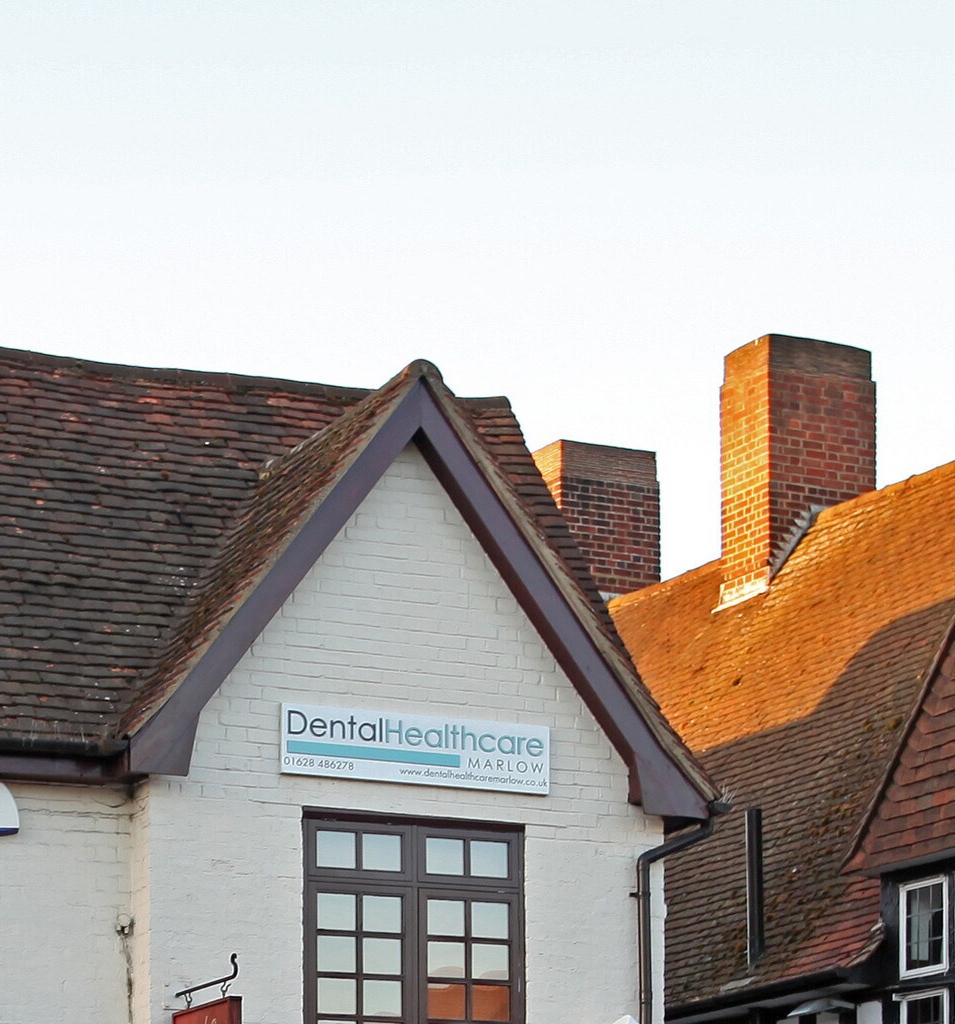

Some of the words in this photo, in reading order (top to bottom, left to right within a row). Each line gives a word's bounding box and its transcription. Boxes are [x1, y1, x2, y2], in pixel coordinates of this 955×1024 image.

[283, 756, 315, 768] 01628
[317, 759, 355, 771] 486278
[467, 757, 544, 774] MARLOW
[399, 767, 548, 788] www.dentalhealthcaremarlow.co.uk
